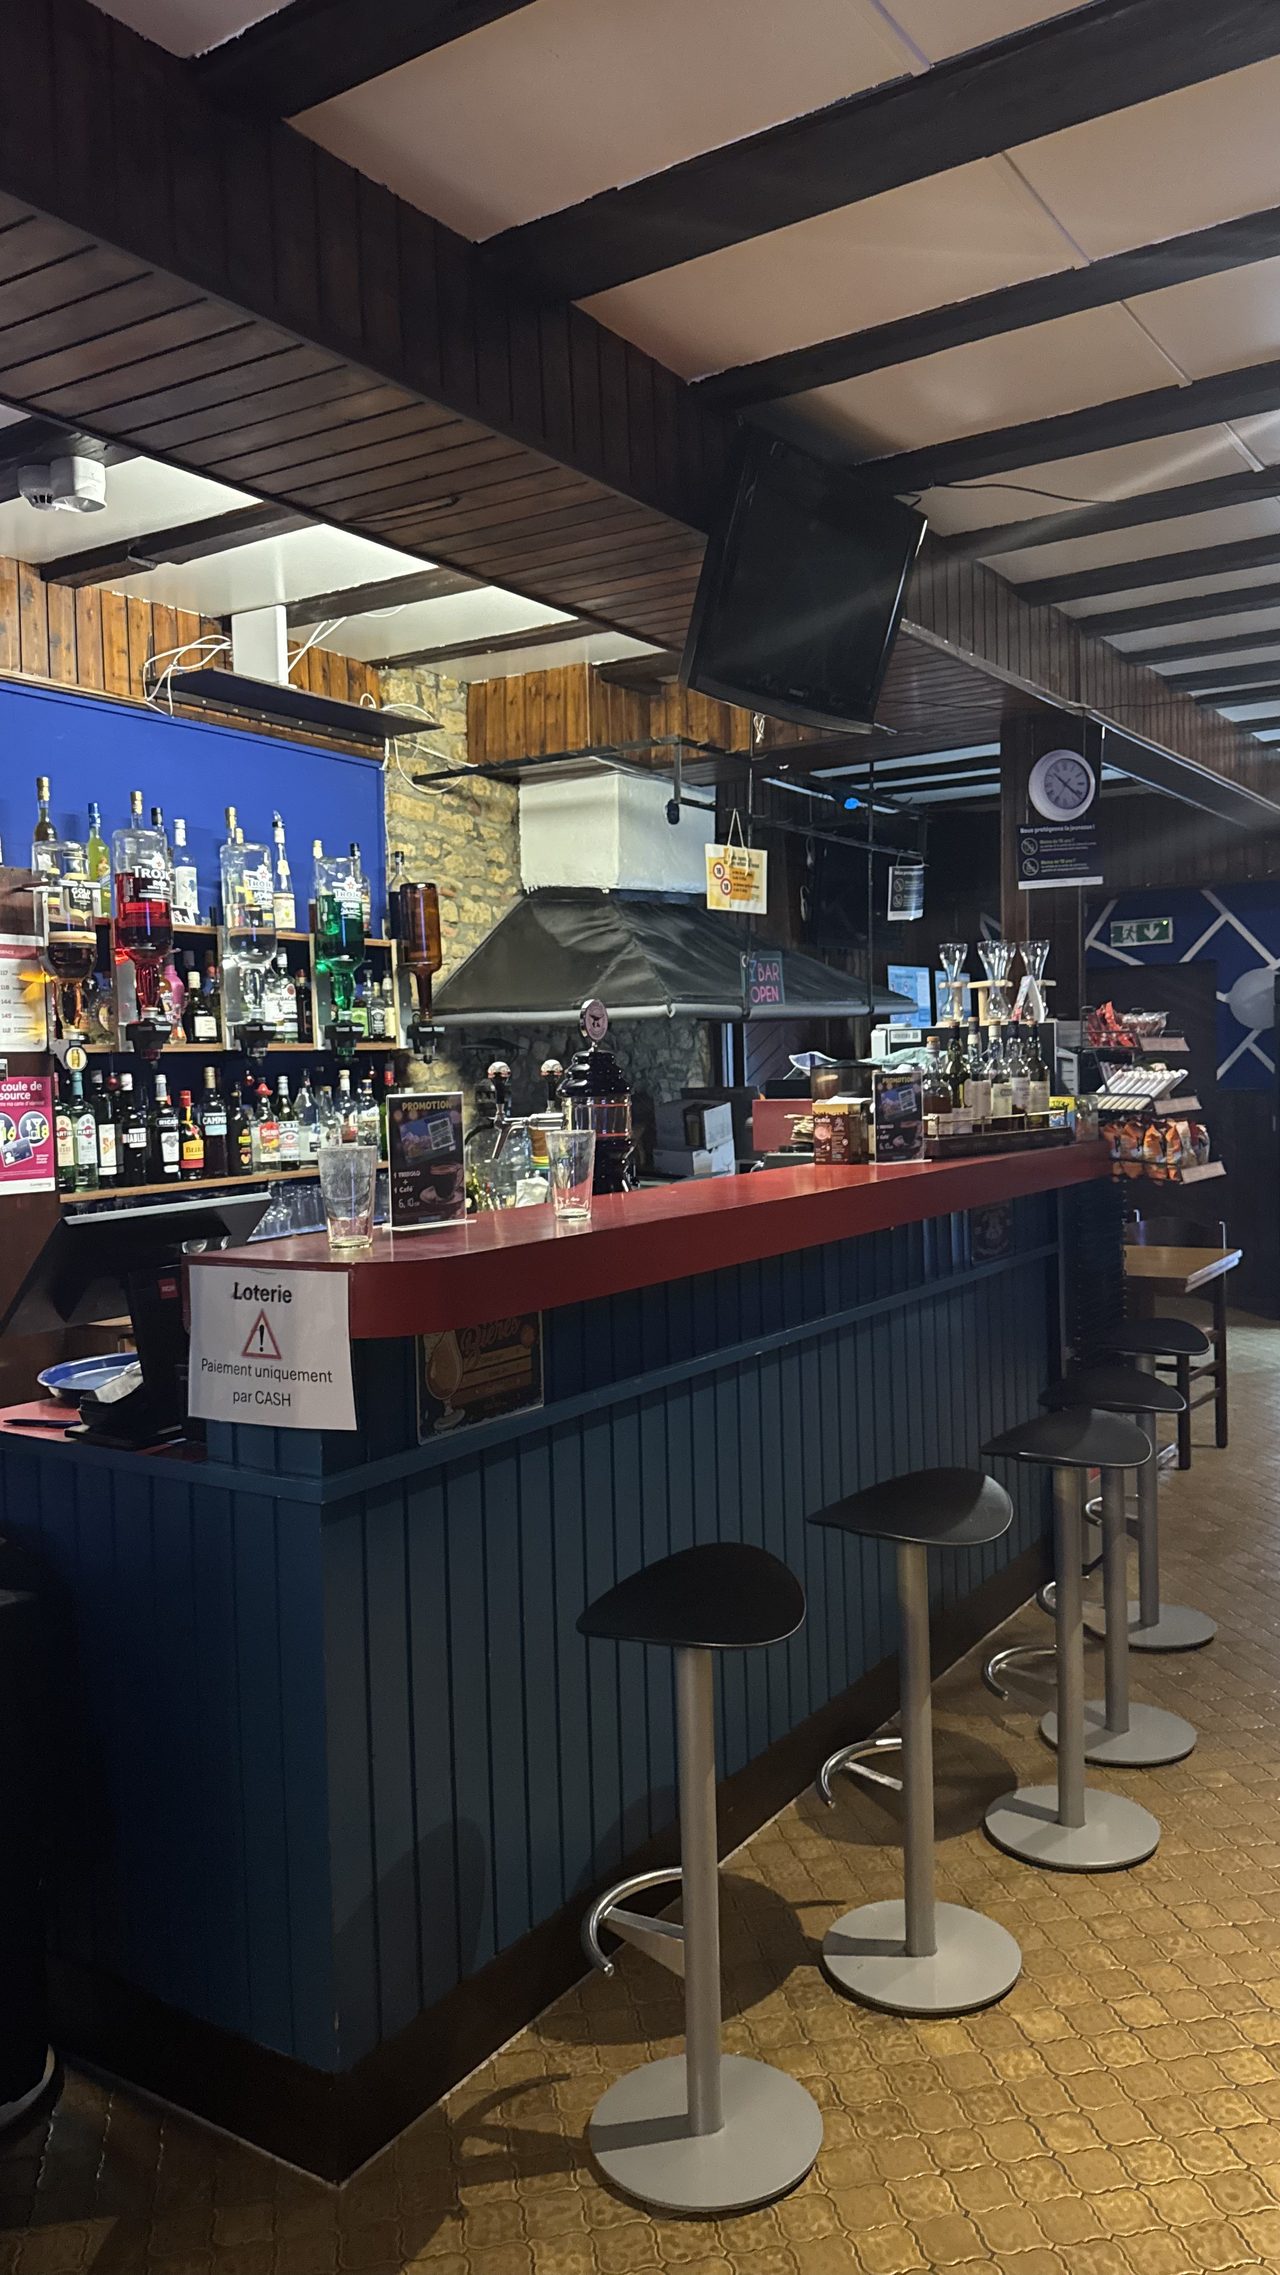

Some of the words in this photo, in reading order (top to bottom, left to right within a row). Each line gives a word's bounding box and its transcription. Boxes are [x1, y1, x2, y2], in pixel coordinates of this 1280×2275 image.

[758, 963, 780, 982] BAR
[751, 985, 779, 1003] OPEN
[1, 1081, 28, 1092] coule
[30, 1081, 42, 1091] de
[0, 1092, 31, 1101] source
[402, 1101, 452, 1111] PROMOTION
[233, 1282, 292, 1303] Loterie
[201, 1358, 252, 1377] Paiement
[255, 1366, 332, 1383] uniquement
[233, 1391, 252, 1404] par
[255, 1390, 291, 1407] CASH
